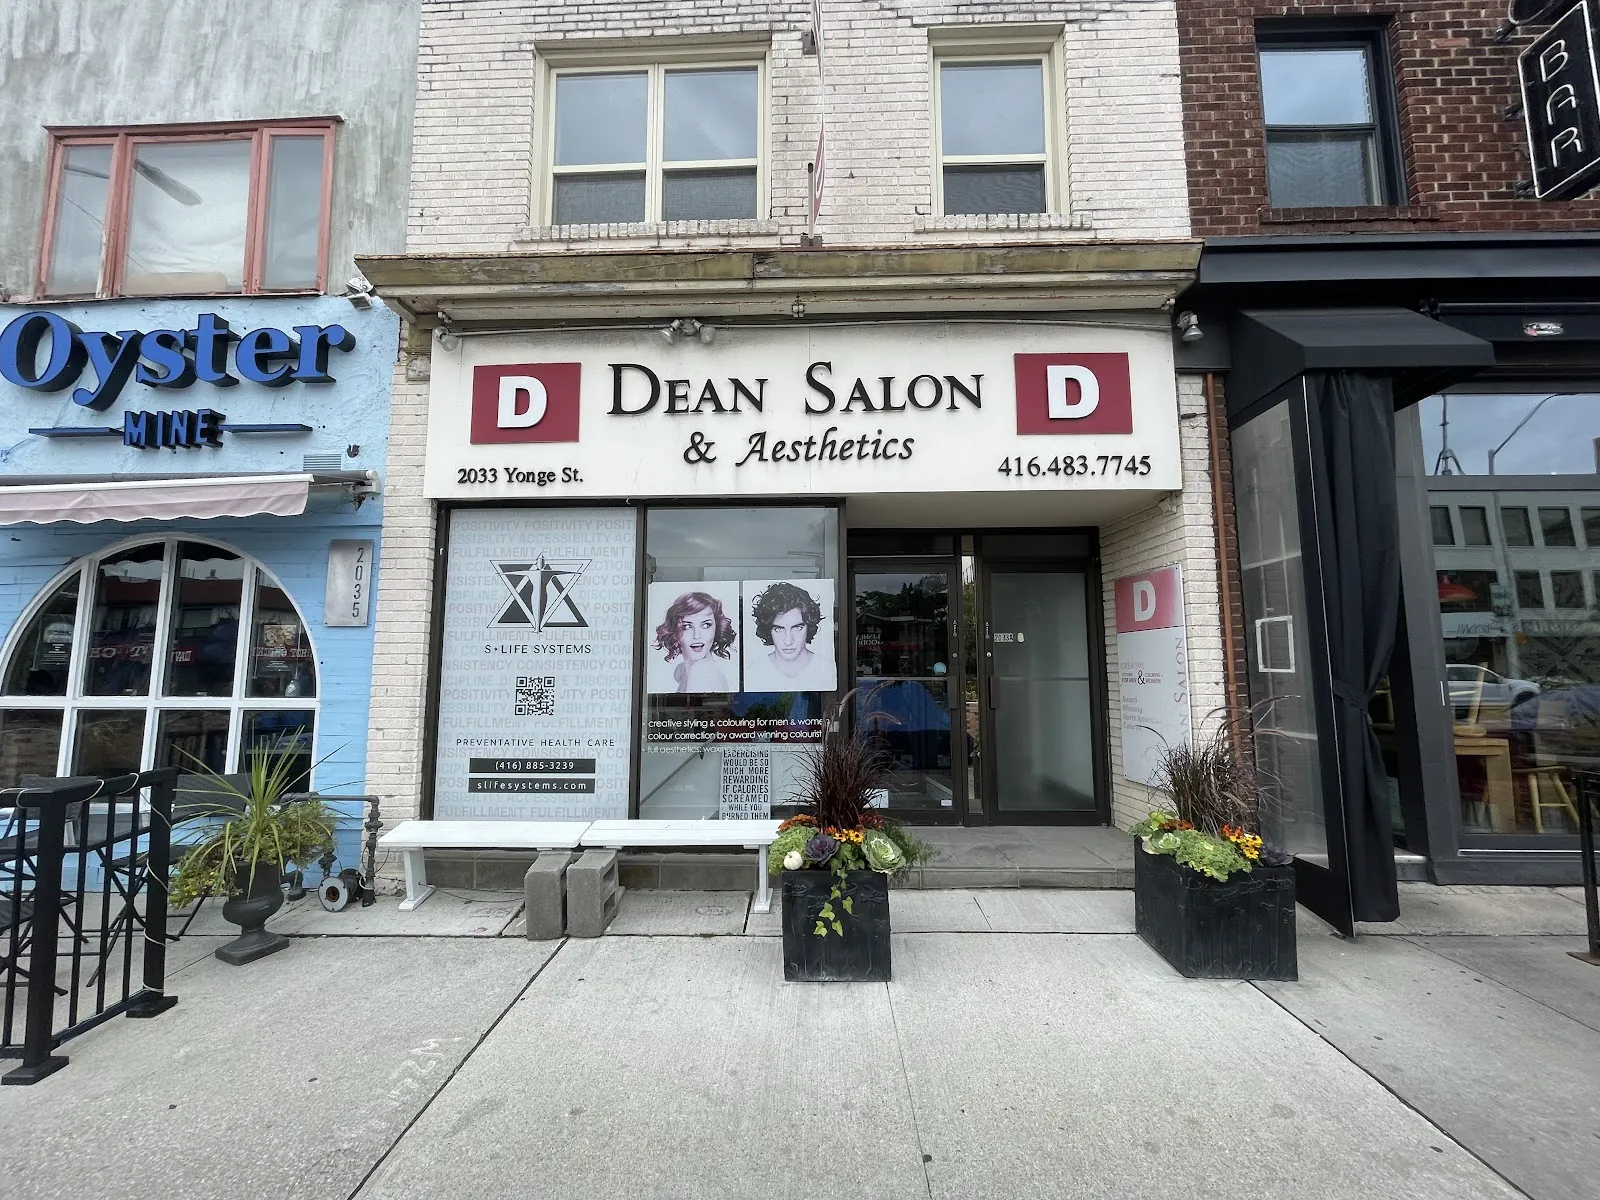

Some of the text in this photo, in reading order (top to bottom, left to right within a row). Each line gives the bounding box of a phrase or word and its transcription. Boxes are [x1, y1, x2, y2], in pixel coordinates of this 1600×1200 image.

[1540, 39, 1583, 168] BAR
[0, 311, 354, 410] Oyster
[606, 361, 986, 416] DEAN SALON
[1047, 365, 1100, 420] D
[497, 376, 548, 429] D
[124, 408, 220, 448] MINE
[683, 426, 915, 467] & Aesthetics
[998, 454, 1152, 478] 416.483.7745
[457, 467, 584, 486] 2033 Yonge St.
[352, 547, 365, 618] 2035
[1133, 580, 1156, 622] D
[534, 644, 592, 654] SYSTEMS
[648, 718, 682, 727] creative
[683, 718, 708, 729] styling
[709, 719, 715, 727] &
[717, 717, 756, 729] colouring
[757, 717, 768, 727] for
[790, 718, 797, 726] &
[648, 731, 673, 740] colour
[674, 731, 716, 740] correction
[717, 730, 728, 741] by
[729, 730, 756, 740] award
[757, 730, 788, 741] winning
[456, 738, 615, 747] PREVENTATIVE HEALTH CARE
[495, 761, 574, 771] (416) 885-3239
[723, 758, 769, 767] WOULD BE SO
[723, 766, 769, 775] MUCH MORE
[723, 775, 769, 784] REWARDING
[477, 781, 587, 791] slifesystems.com
[723, 784, 769, 794] IF CALORIES
[722, 794, 769, 803] SCREAMED
[728, 803, 762, 811] WHILE YOU
[722, 812, 769, 820] BURNED THEM
